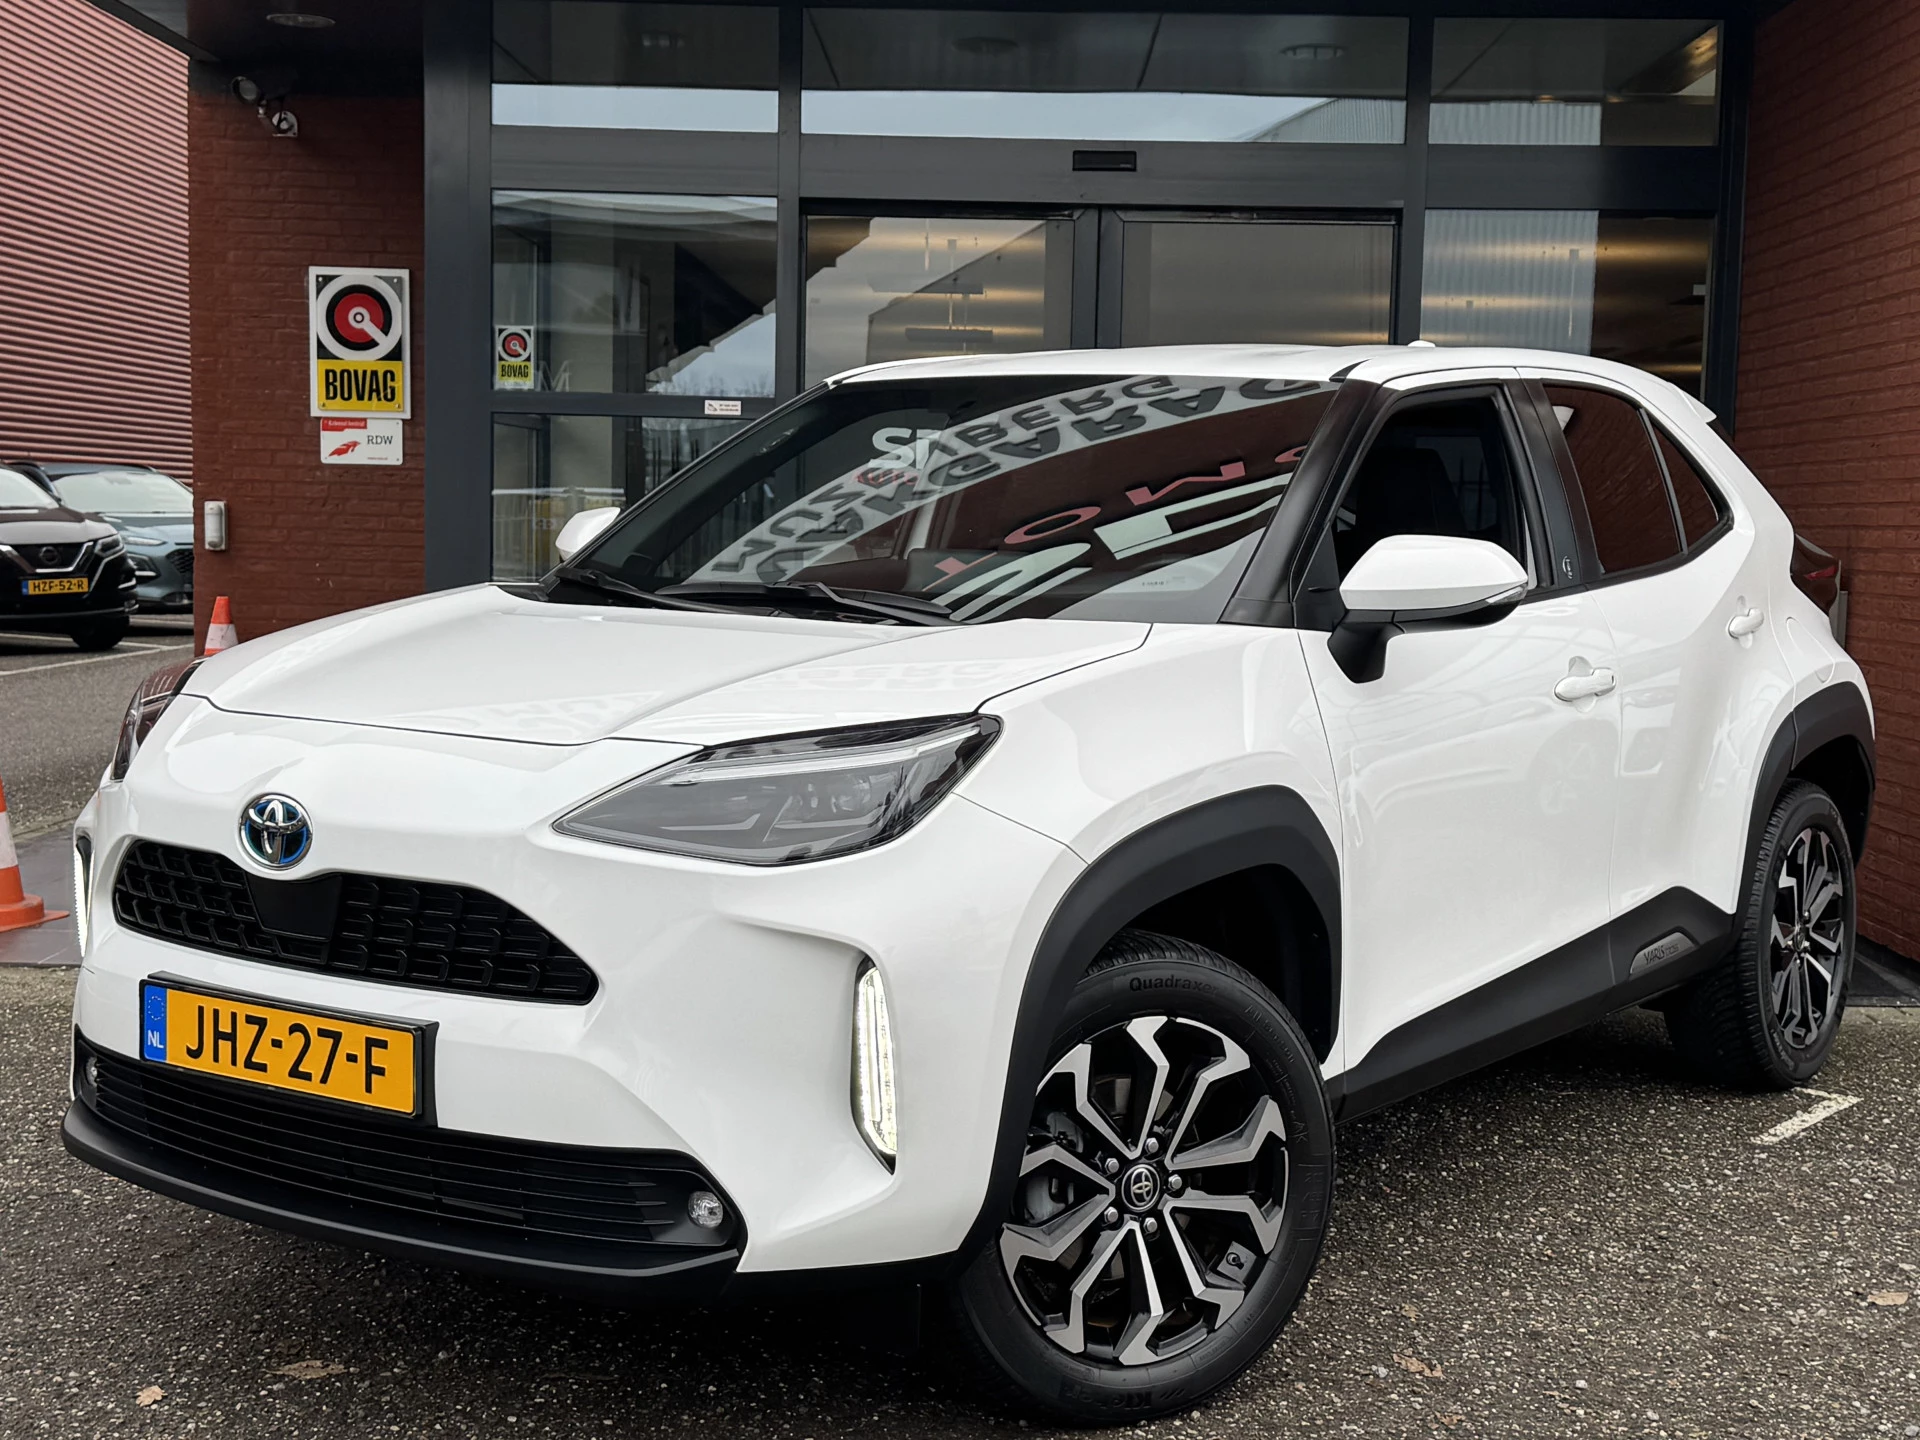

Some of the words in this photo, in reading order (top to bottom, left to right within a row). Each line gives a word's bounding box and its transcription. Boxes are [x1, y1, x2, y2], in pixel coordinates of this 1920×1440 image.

[501, 364, 529, 378] BOVAG
[325, 368, 396, 403] BOVAG
[366, 434, 394, 446] RDW
[33, 580, 84, 593] HZF-52-R
[147, 1030, 164, 1049] NL
[186, 1004, 389, 1094] JHZ-27-F
